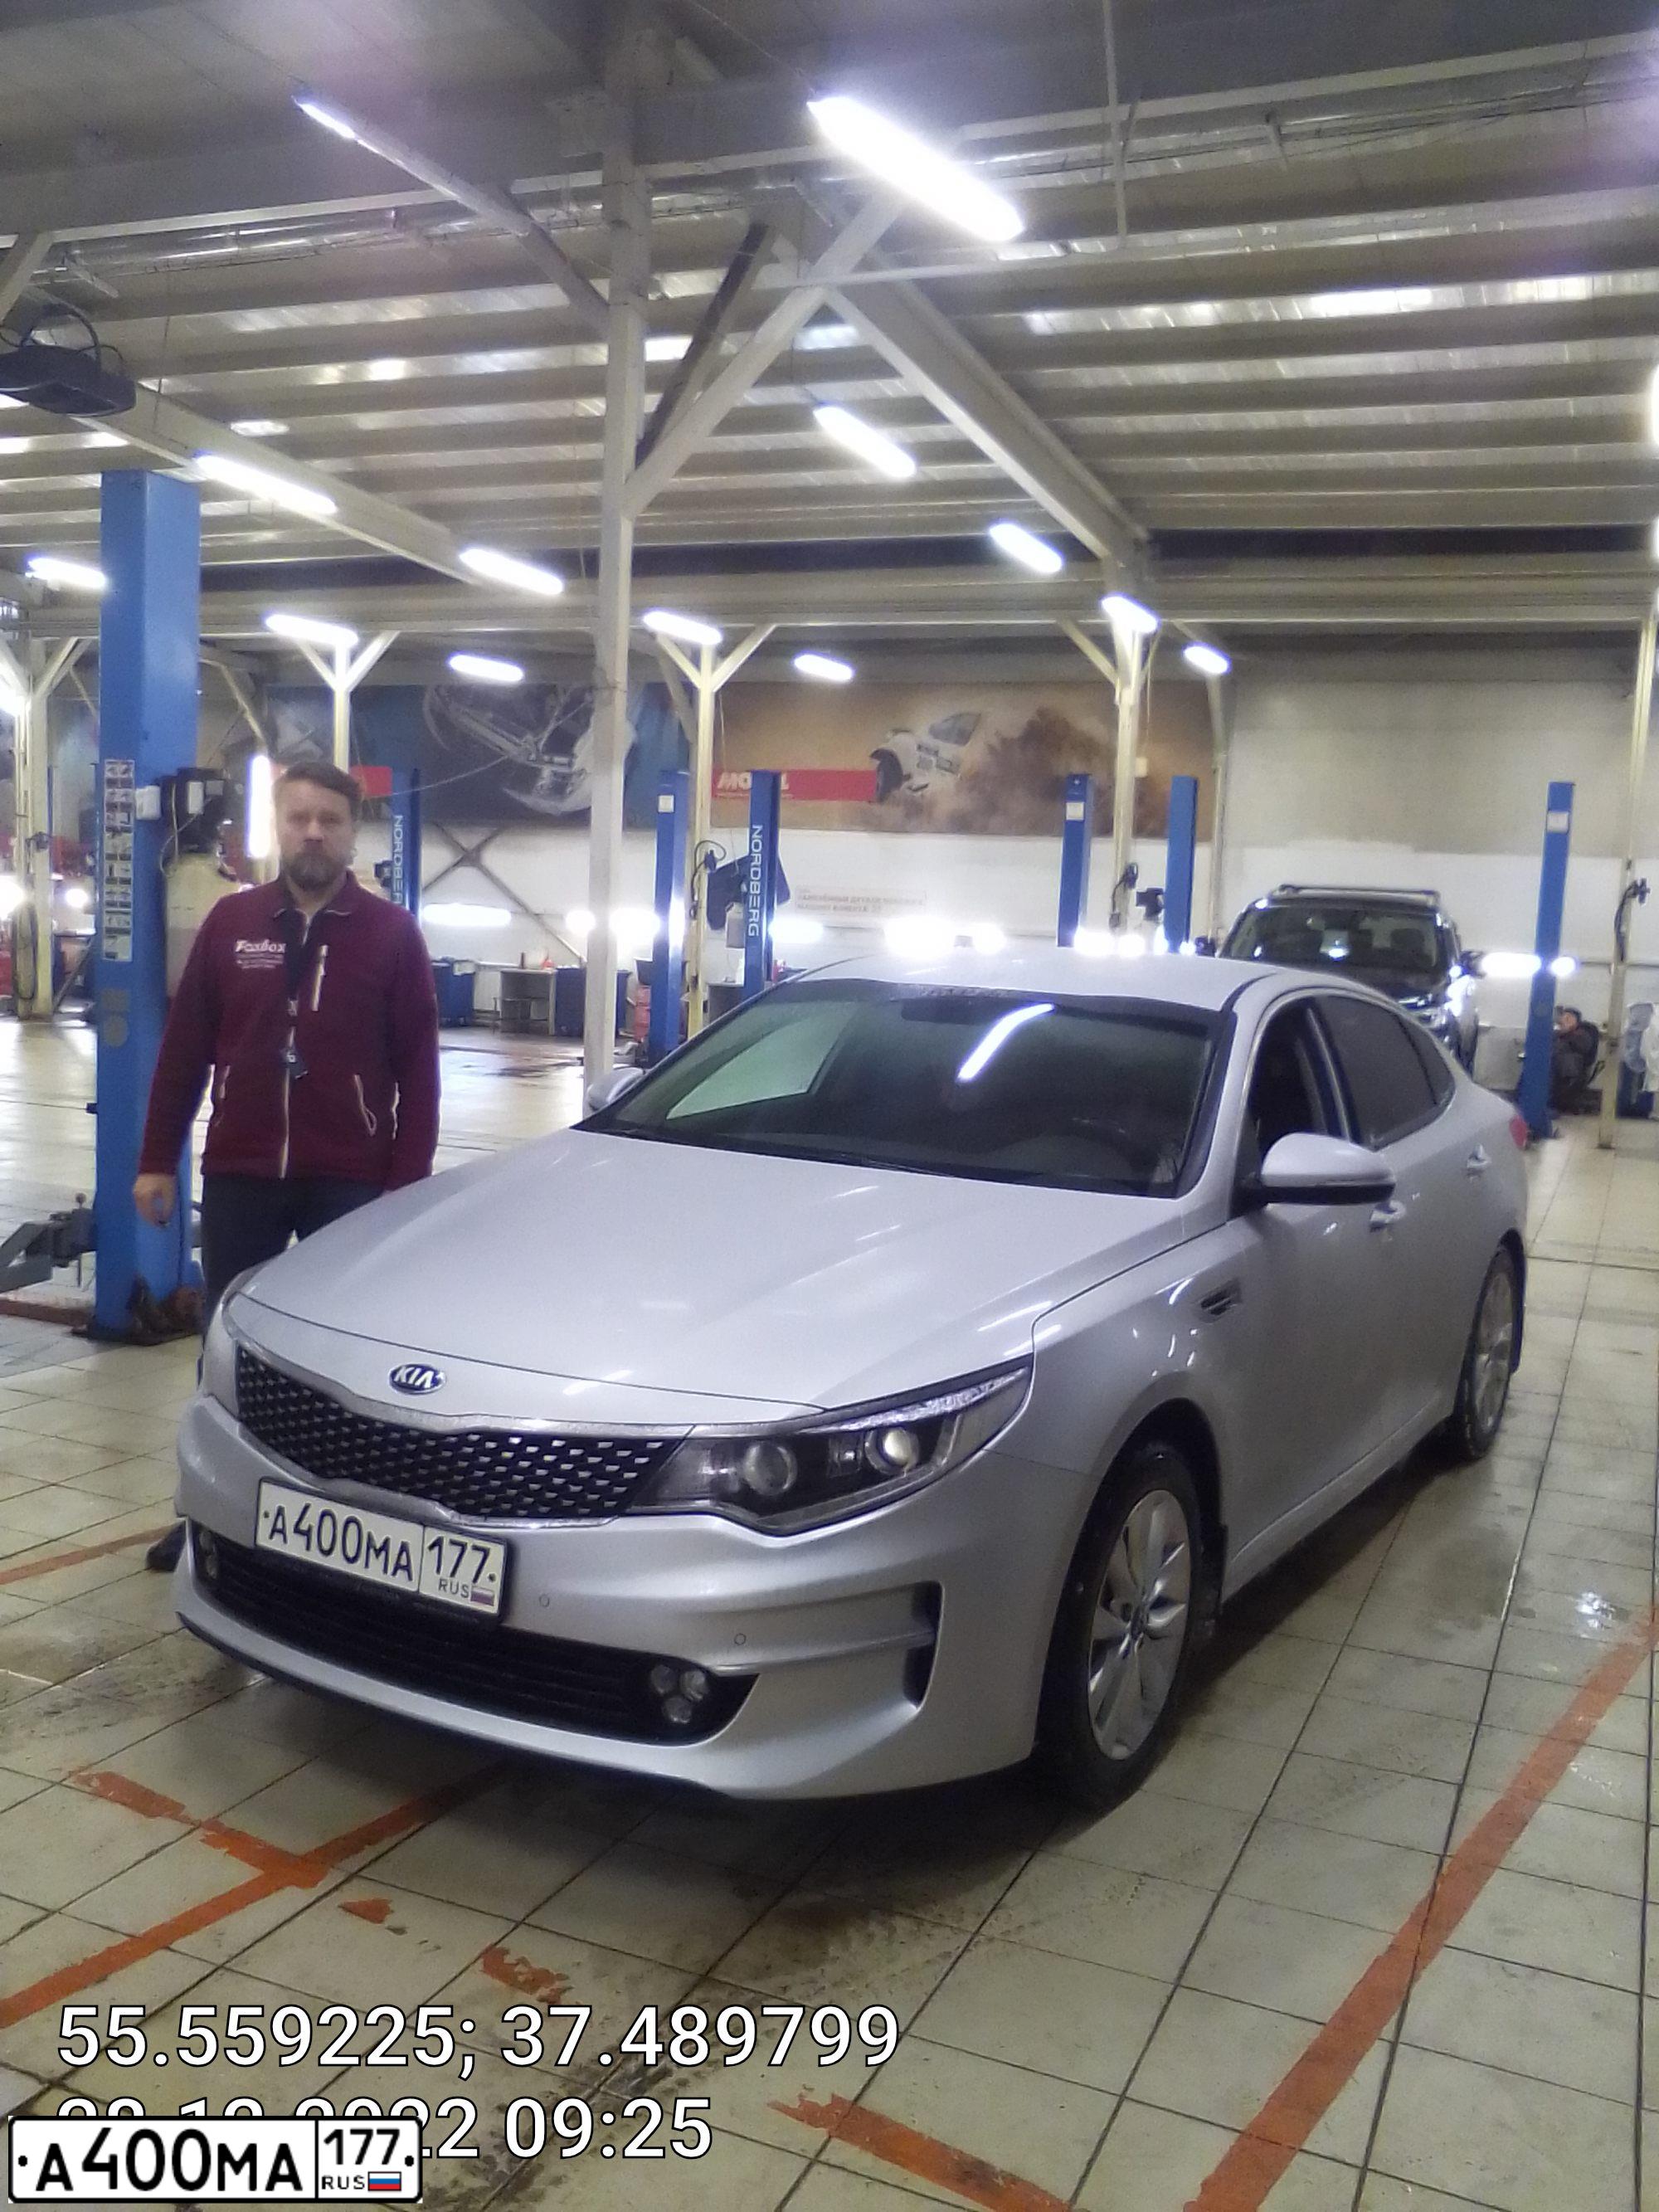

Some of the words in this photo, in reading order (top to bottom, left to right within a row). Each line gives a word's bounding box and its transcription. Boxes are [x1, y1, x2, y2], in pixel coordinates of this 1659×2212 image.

[718, 772, 789, 790] MOL
[393, 815, 403, 904] NORDBER
[748, 825, 762, 937] NORDBERG
[394, 1367, 434, 1388] KIA
[428, 1536, 490, 1583] 177
[438, 1578, 469, 1598] RUS
